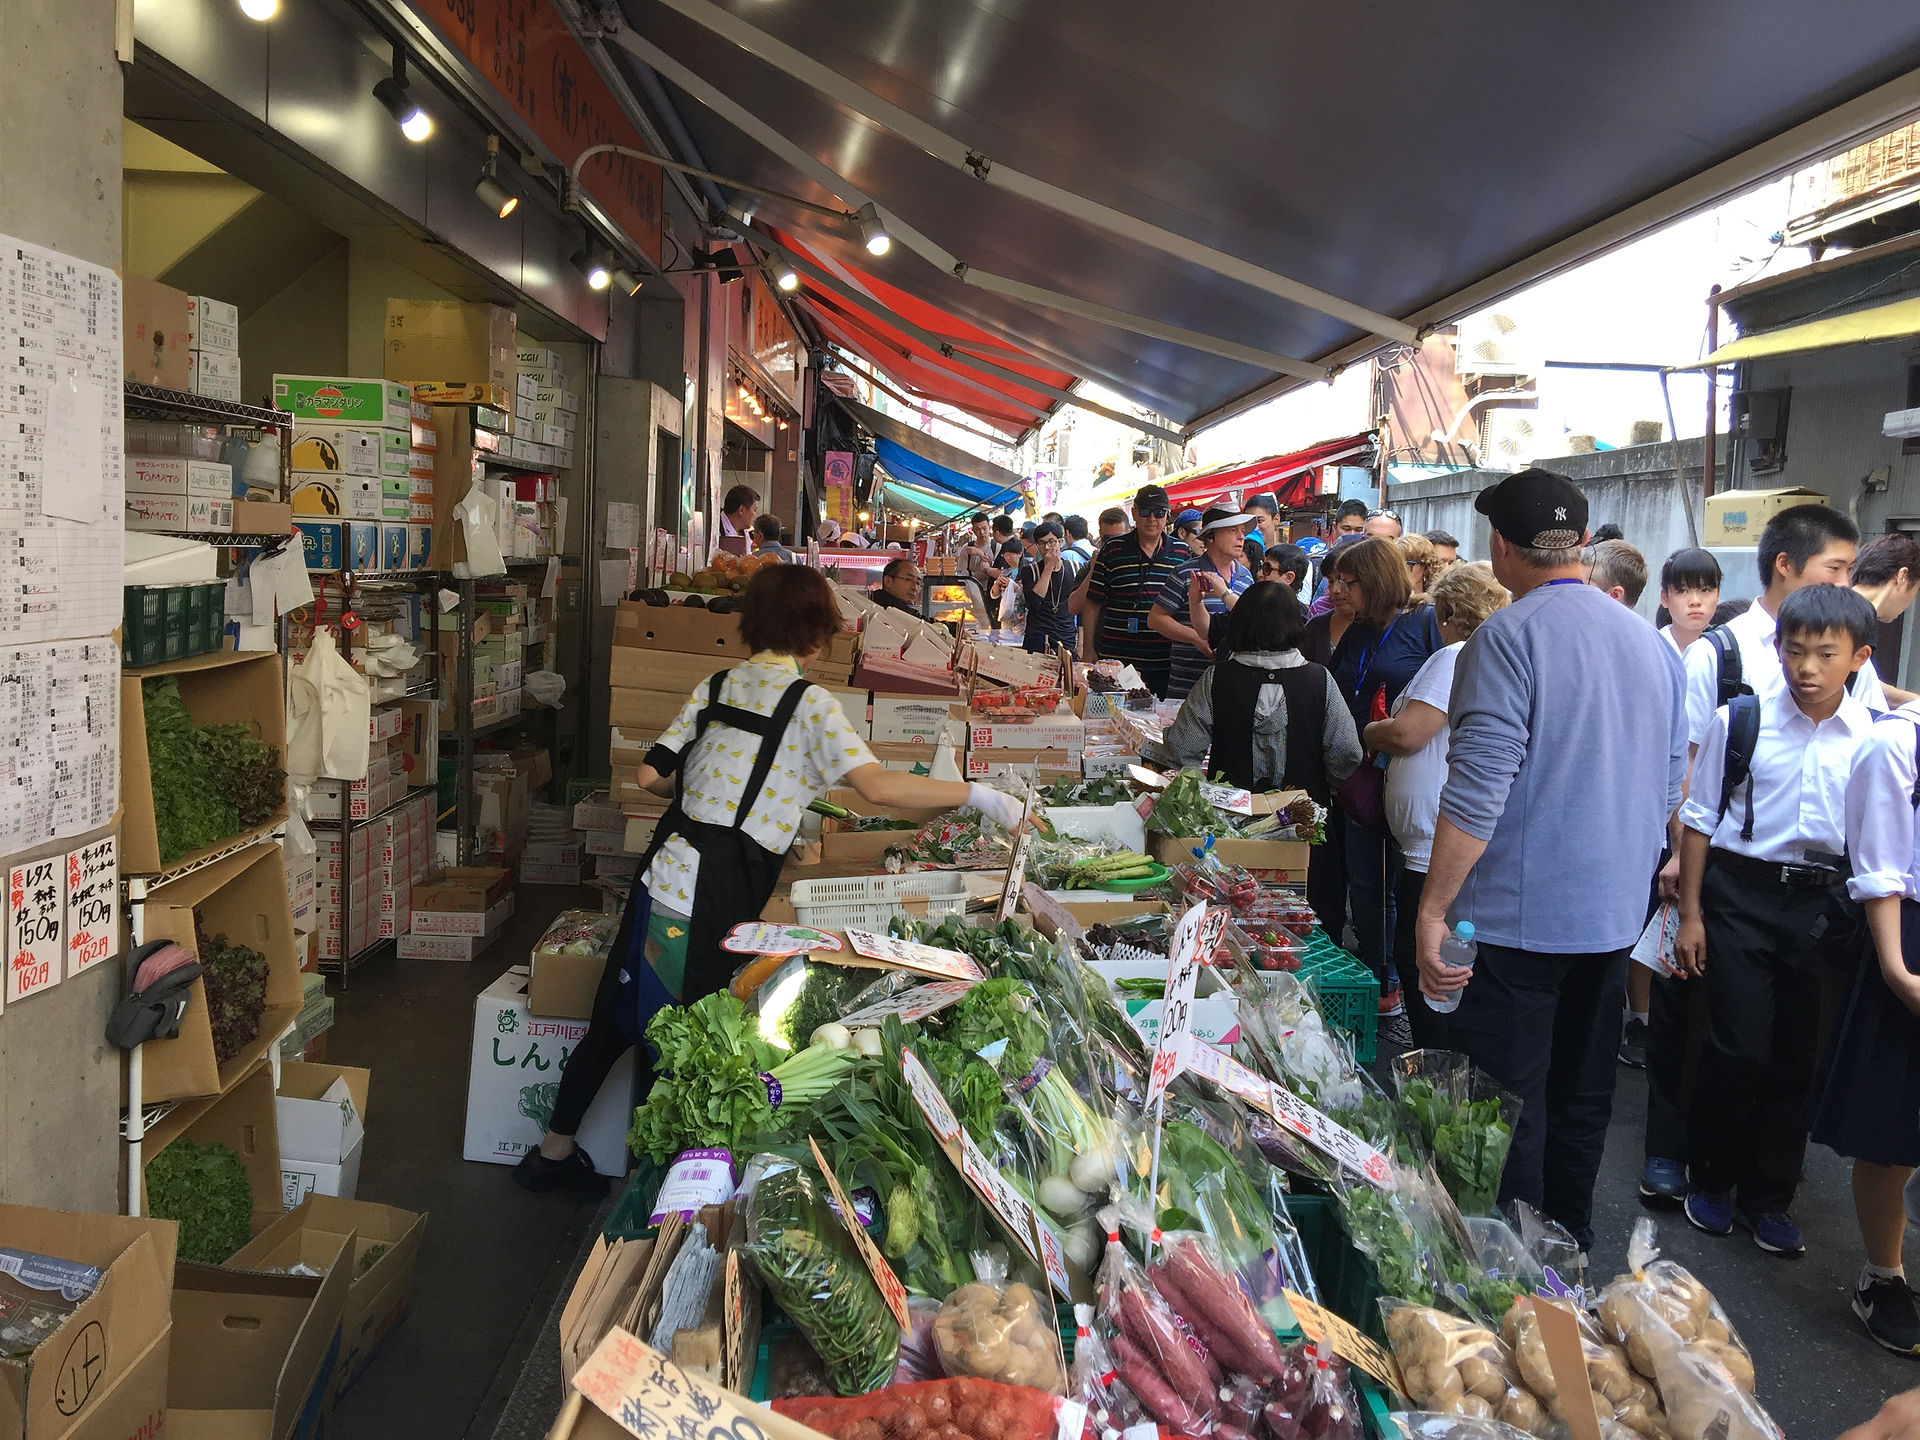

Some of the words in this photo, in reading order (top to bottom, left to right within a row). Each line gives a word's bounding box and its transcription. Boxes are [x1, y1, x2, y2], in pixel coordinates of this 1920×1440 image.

[306, 396, 363, 408] カラマンダリン
[136, 471, 180, 483] TOMATO
[139, 509, 179, 521] TOMATO
[1554, 507, 1567, 521] NY
[26, 863, 53, 888] レタス
[79, 899, 111, 930] 150円
[19, 916, 59, 949] 150円
[78, 936, 108, 969] 162円
[18, 961, 49, 994] 162円
[713, 1151, 726, 1159] JA
